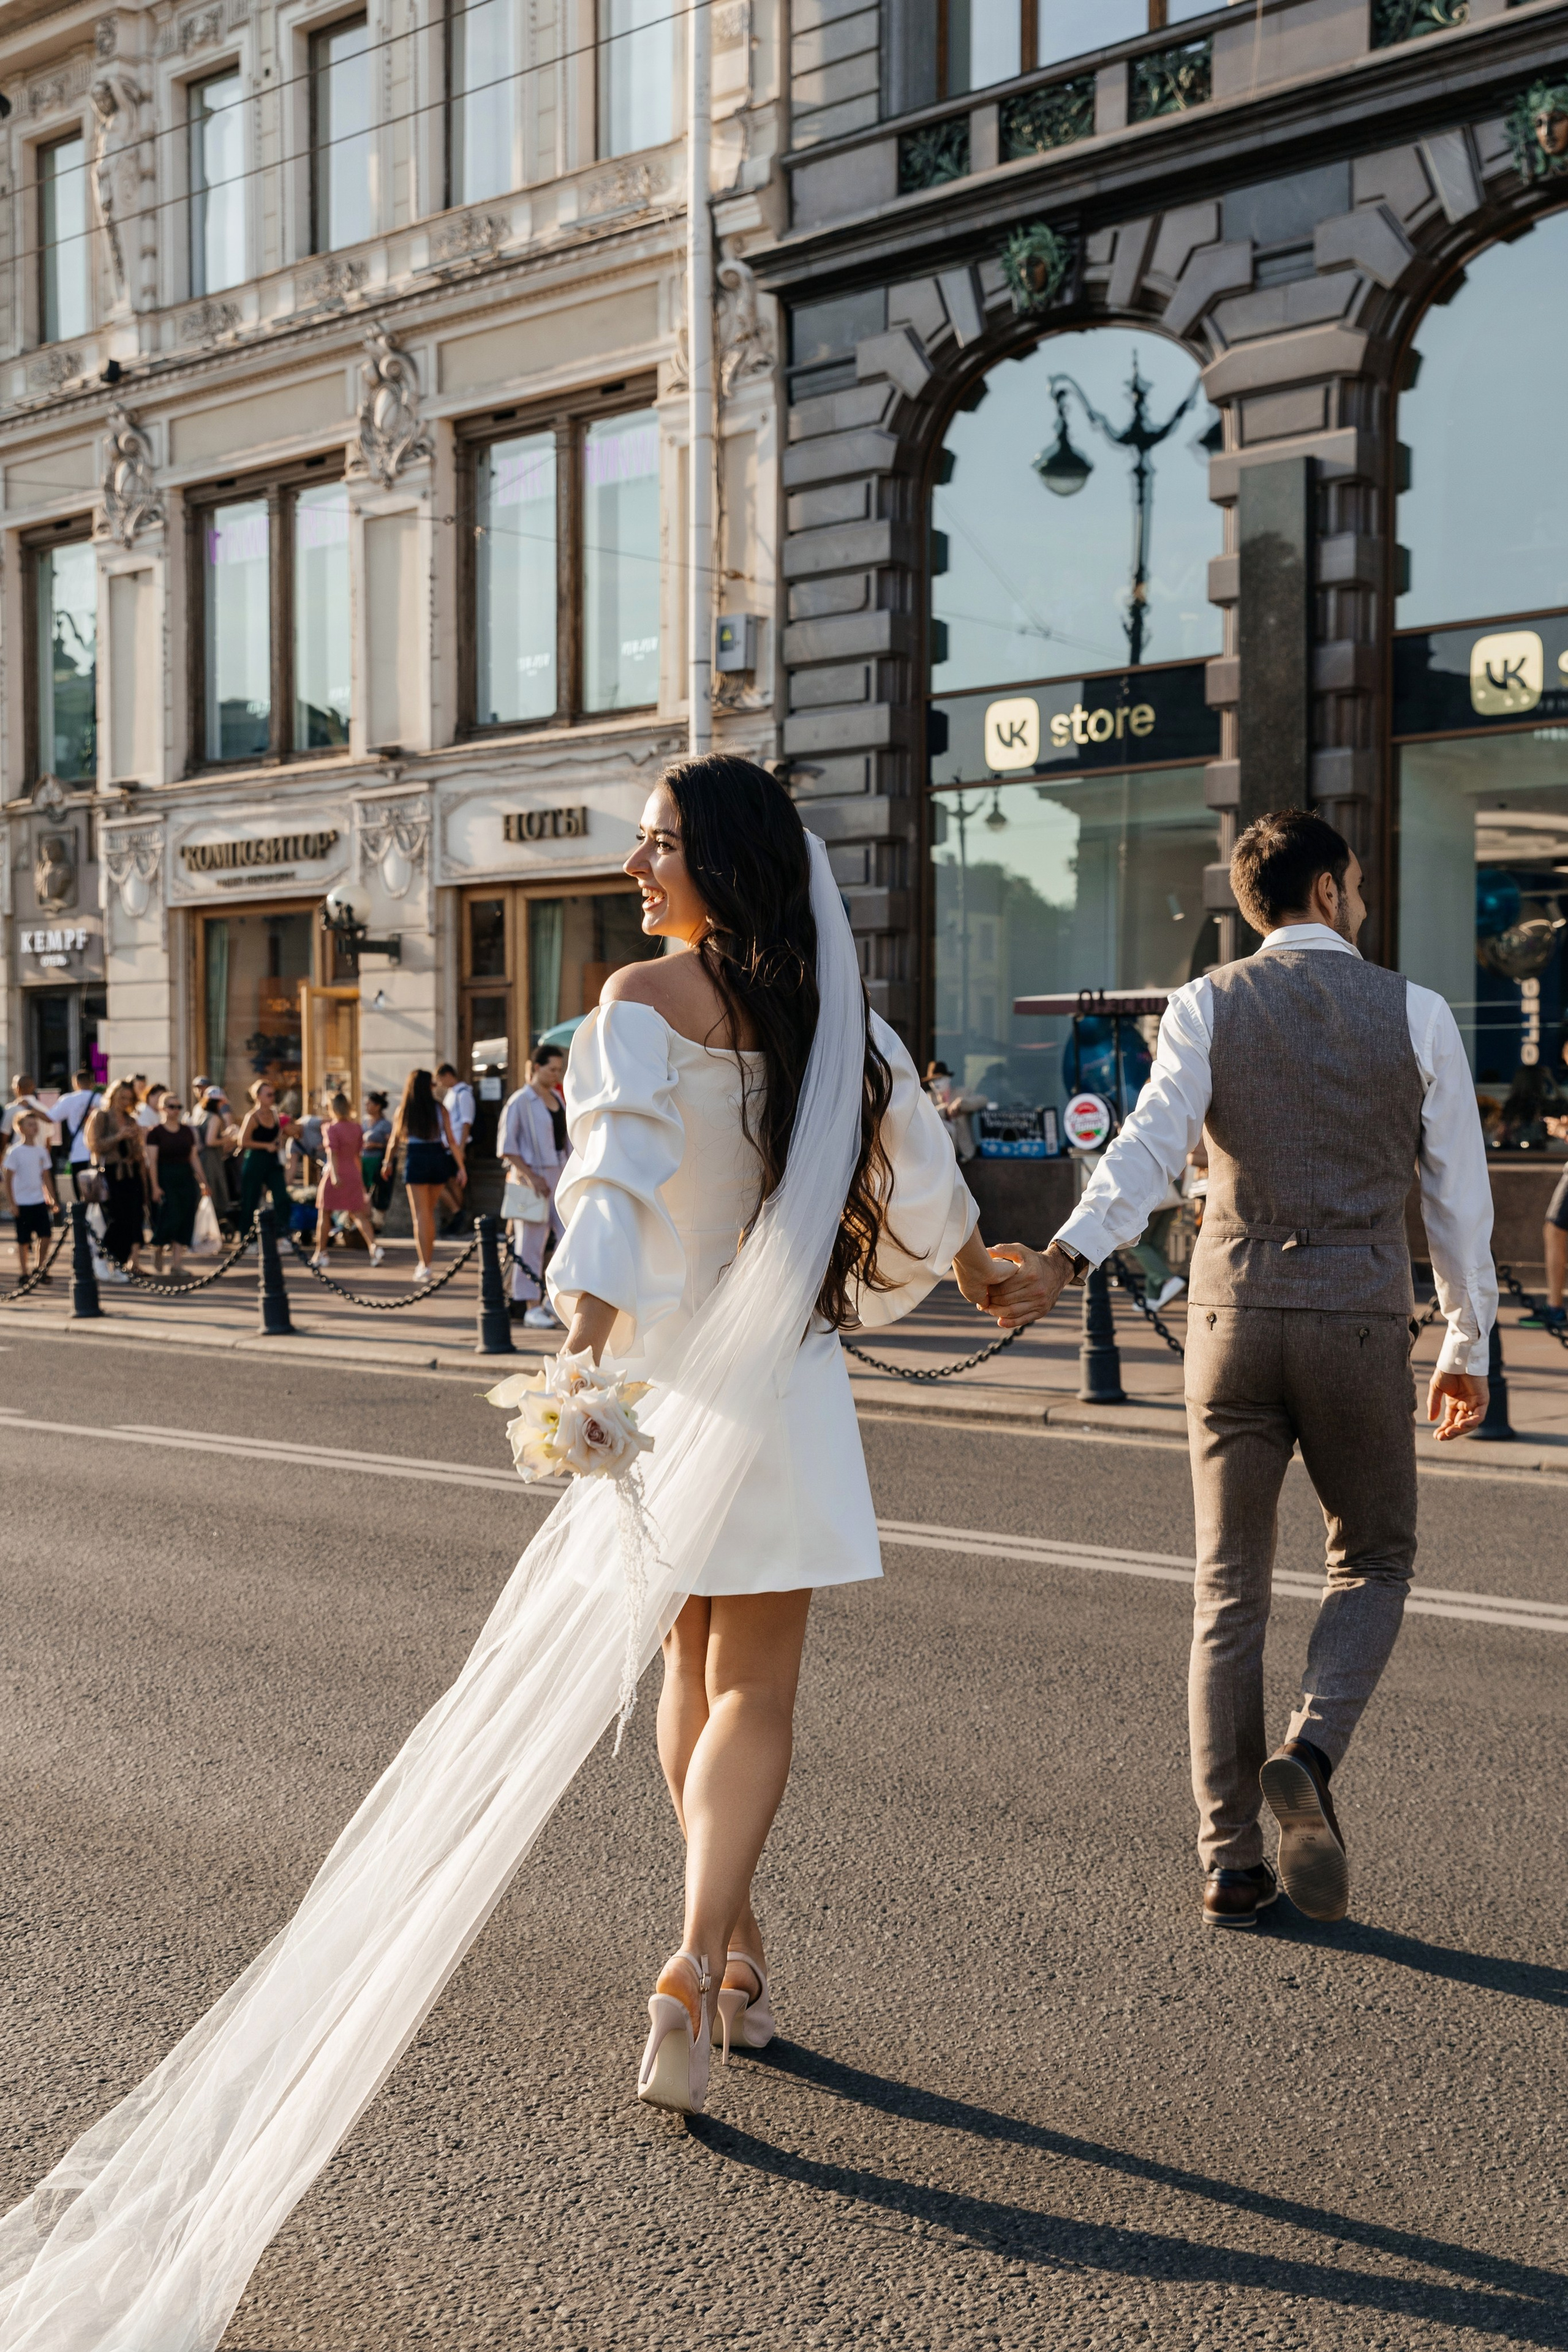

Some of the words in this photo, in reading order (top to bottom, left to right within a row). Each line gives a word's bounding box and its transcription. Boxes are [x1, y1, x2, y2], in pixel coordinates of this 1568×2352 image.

[1485, 657, 1527, 689] VK
[996, 720, 1028, 748] VK
[1049, 703, 1156, 748] store
[503, 805, 589, 842] НОТЫ
[20, 927, 88, 953] KEMPF
